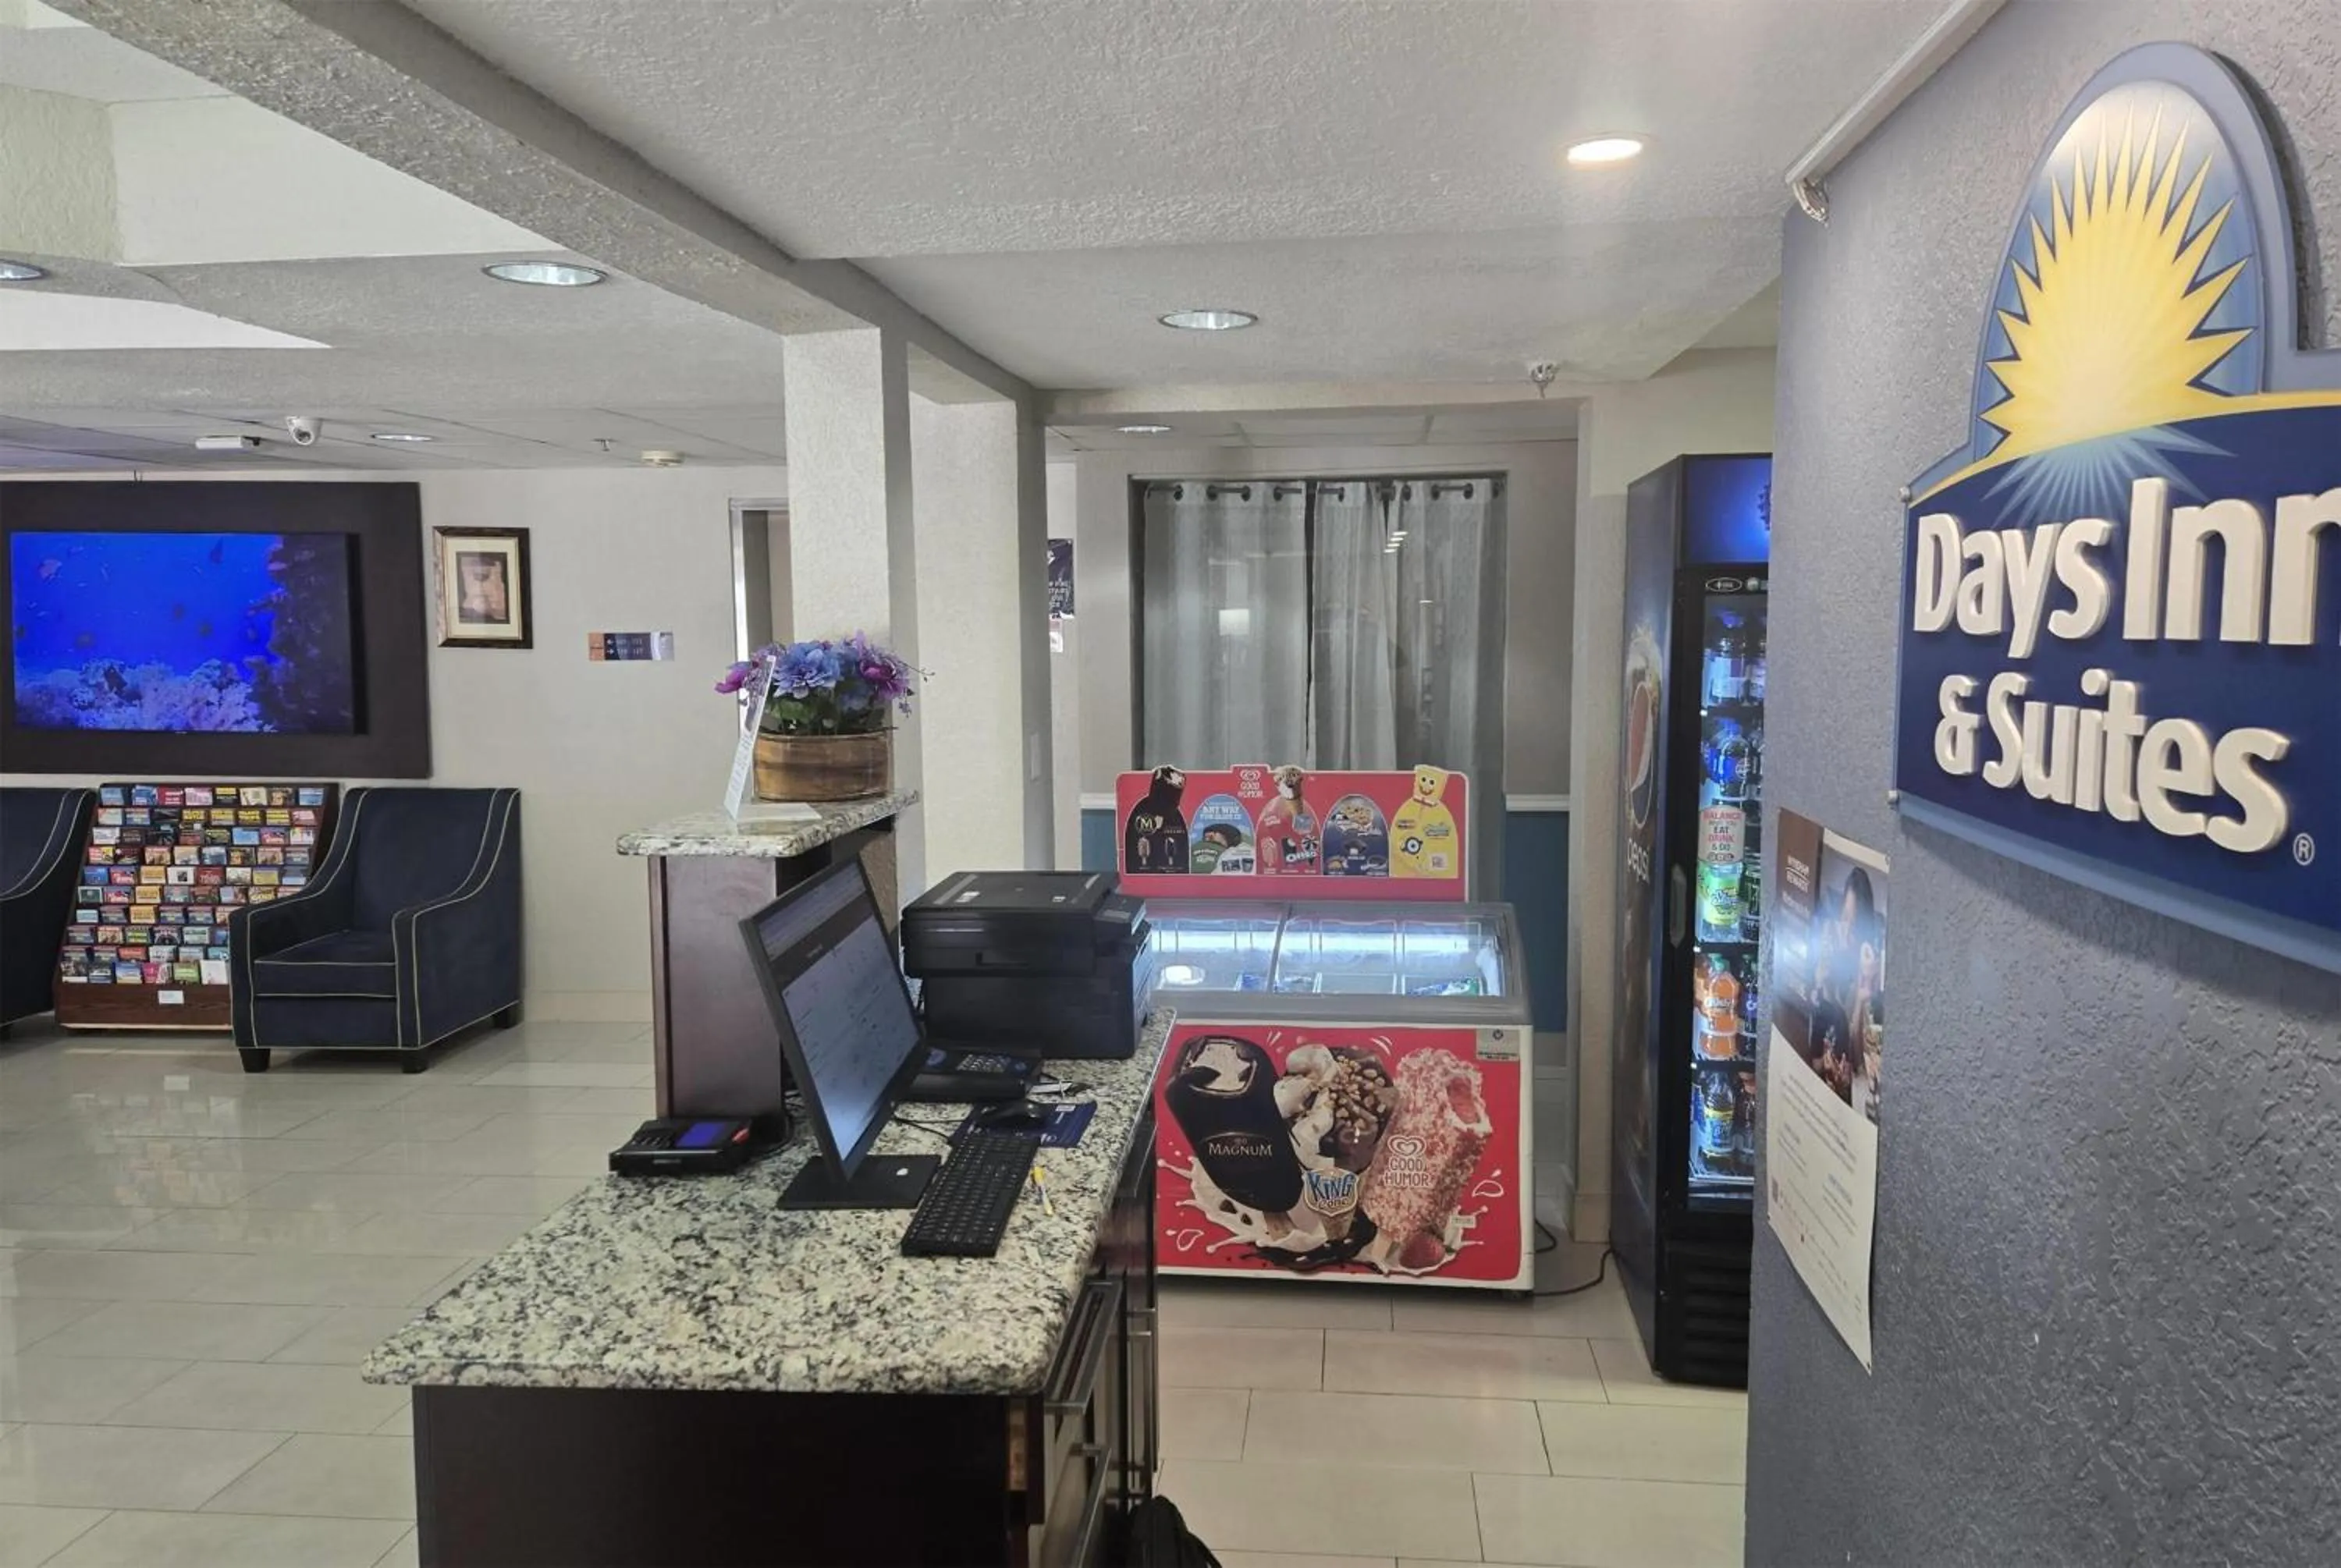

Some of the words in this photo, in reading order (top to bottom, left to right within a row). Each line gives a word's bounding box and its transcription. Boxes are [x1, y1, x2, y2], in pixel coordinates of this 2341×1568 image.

[1914, 513, 2113, 659] Days
[1934, 675, 1981, 775] &
[1982, 669, 2290, 853] Suites
[1708, 834, 1735, 843] DRINK
[1627, 836, 1650, 886] pepsi
[1208, 1142, 1274, 1157] MAGNUM
[1390, 1158, 1424, 1172] GOOD
[1384, 1172, 1430, 1187] HUMOR
